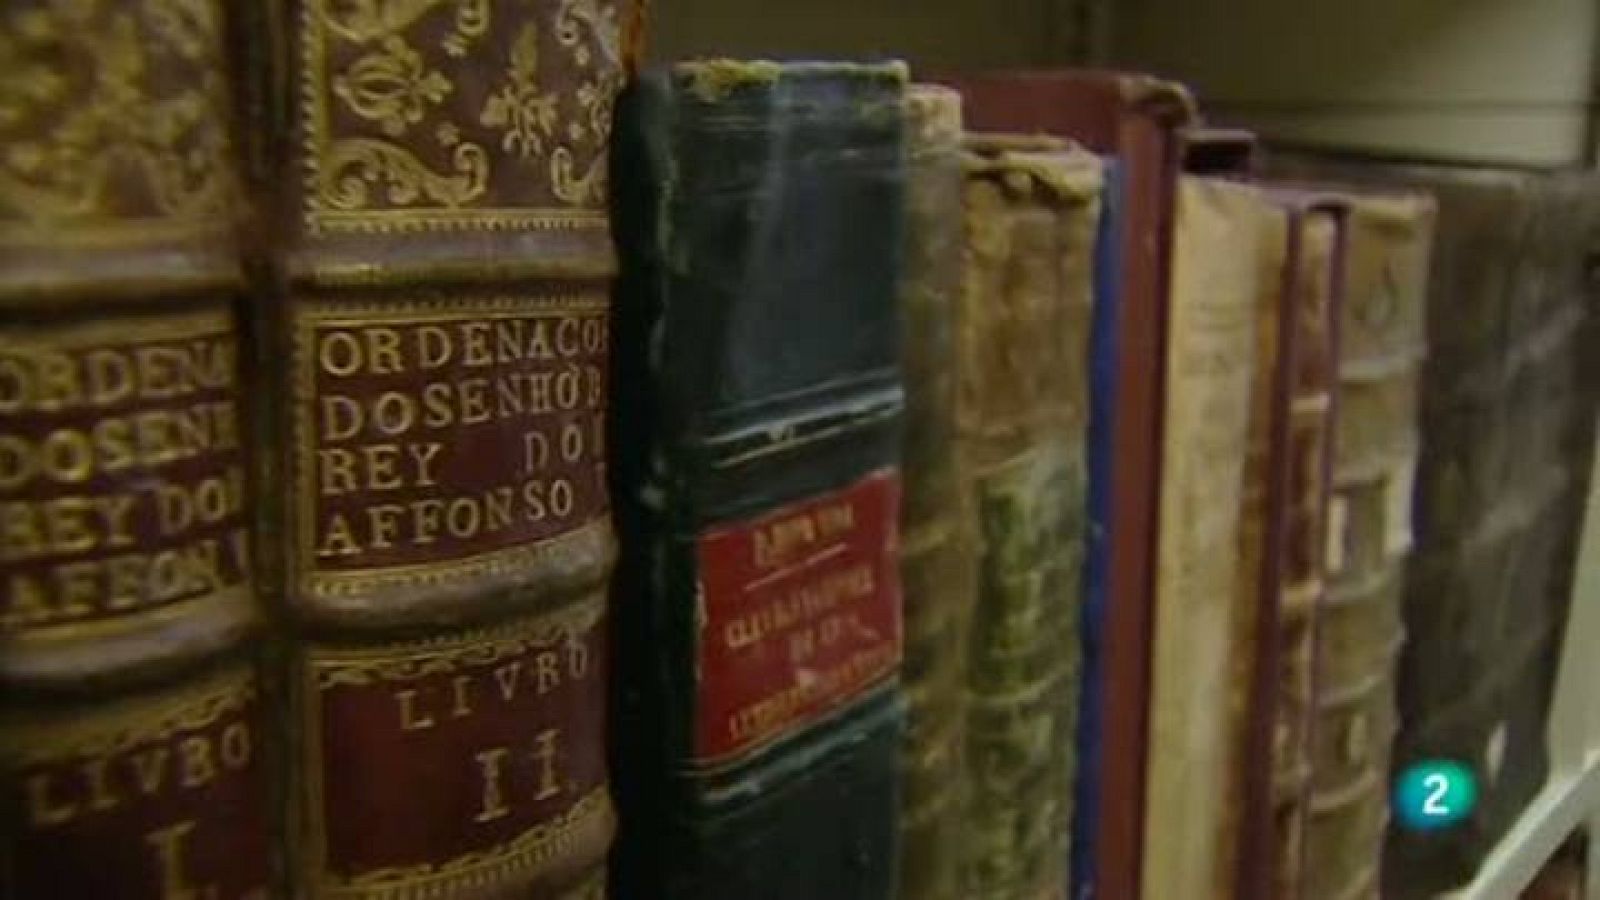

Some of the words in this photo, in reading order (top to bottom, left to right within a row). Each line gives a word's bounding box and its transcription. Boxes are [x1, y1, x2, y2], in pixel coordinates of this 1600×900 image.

[320, 318, 608, 376] ORDENACO
[320, 443, 443, 494] REY
[319, 479, 574, 556] AFFONSO
[395, 633, 588, 730] LIVRO
[27, 722, 250, 828] LIVRO
[472, 729, 561, 823] II
